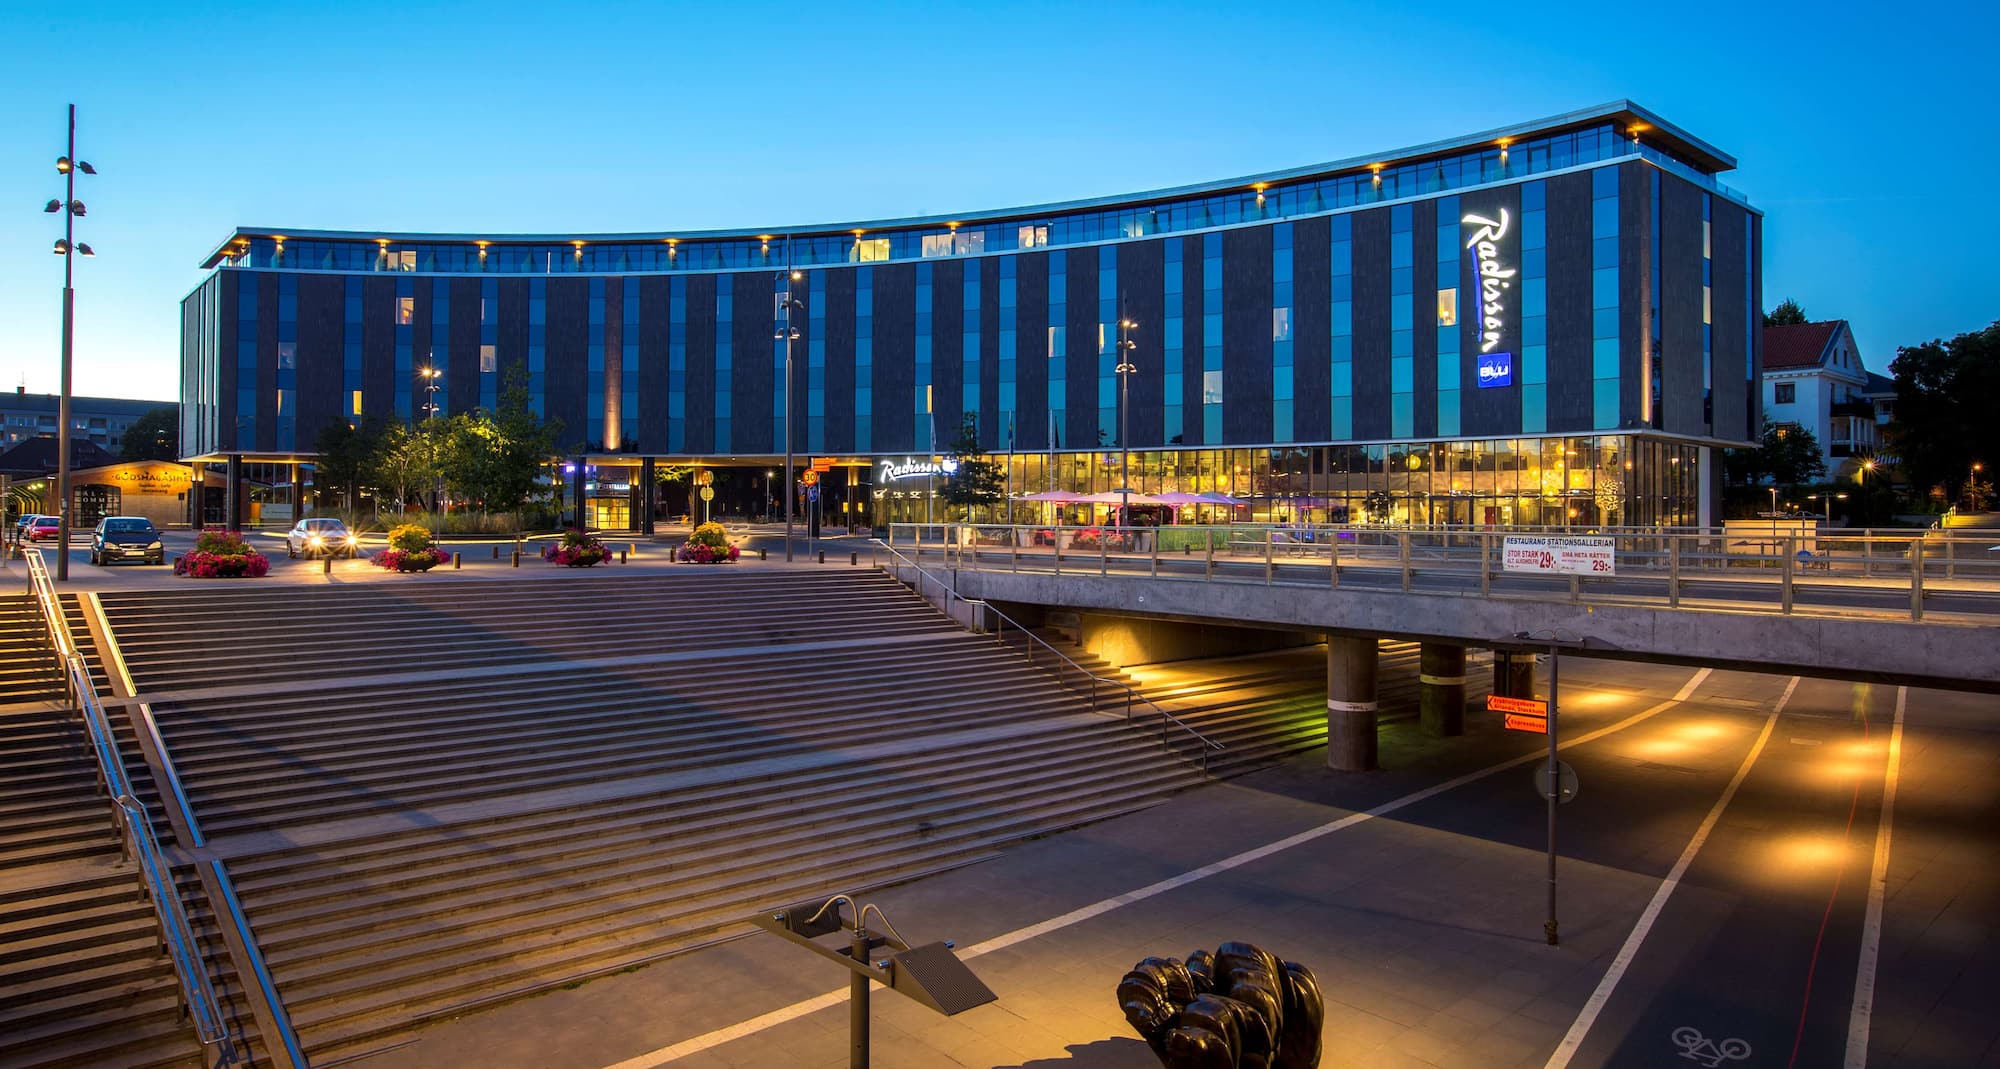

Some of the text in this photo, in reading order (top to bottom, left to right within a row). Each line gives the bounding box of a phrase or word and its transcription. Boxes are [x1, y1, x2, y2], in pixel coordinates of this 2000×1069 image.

[1461, 207, 1516, 353] Radisson
[1479, 366, 1509, 379] BLU
[879, 456, 942, 484] Radisson
[804, 473, 815, 481] 30
[1506, 537, 1546, 545] RESTAURANG
[1547, 538, 1614, 547] STATIONSGALLERIAN
[1539, 551, 1557, 568] 29:-
[1592, 560, 1611, 572] 29:-
